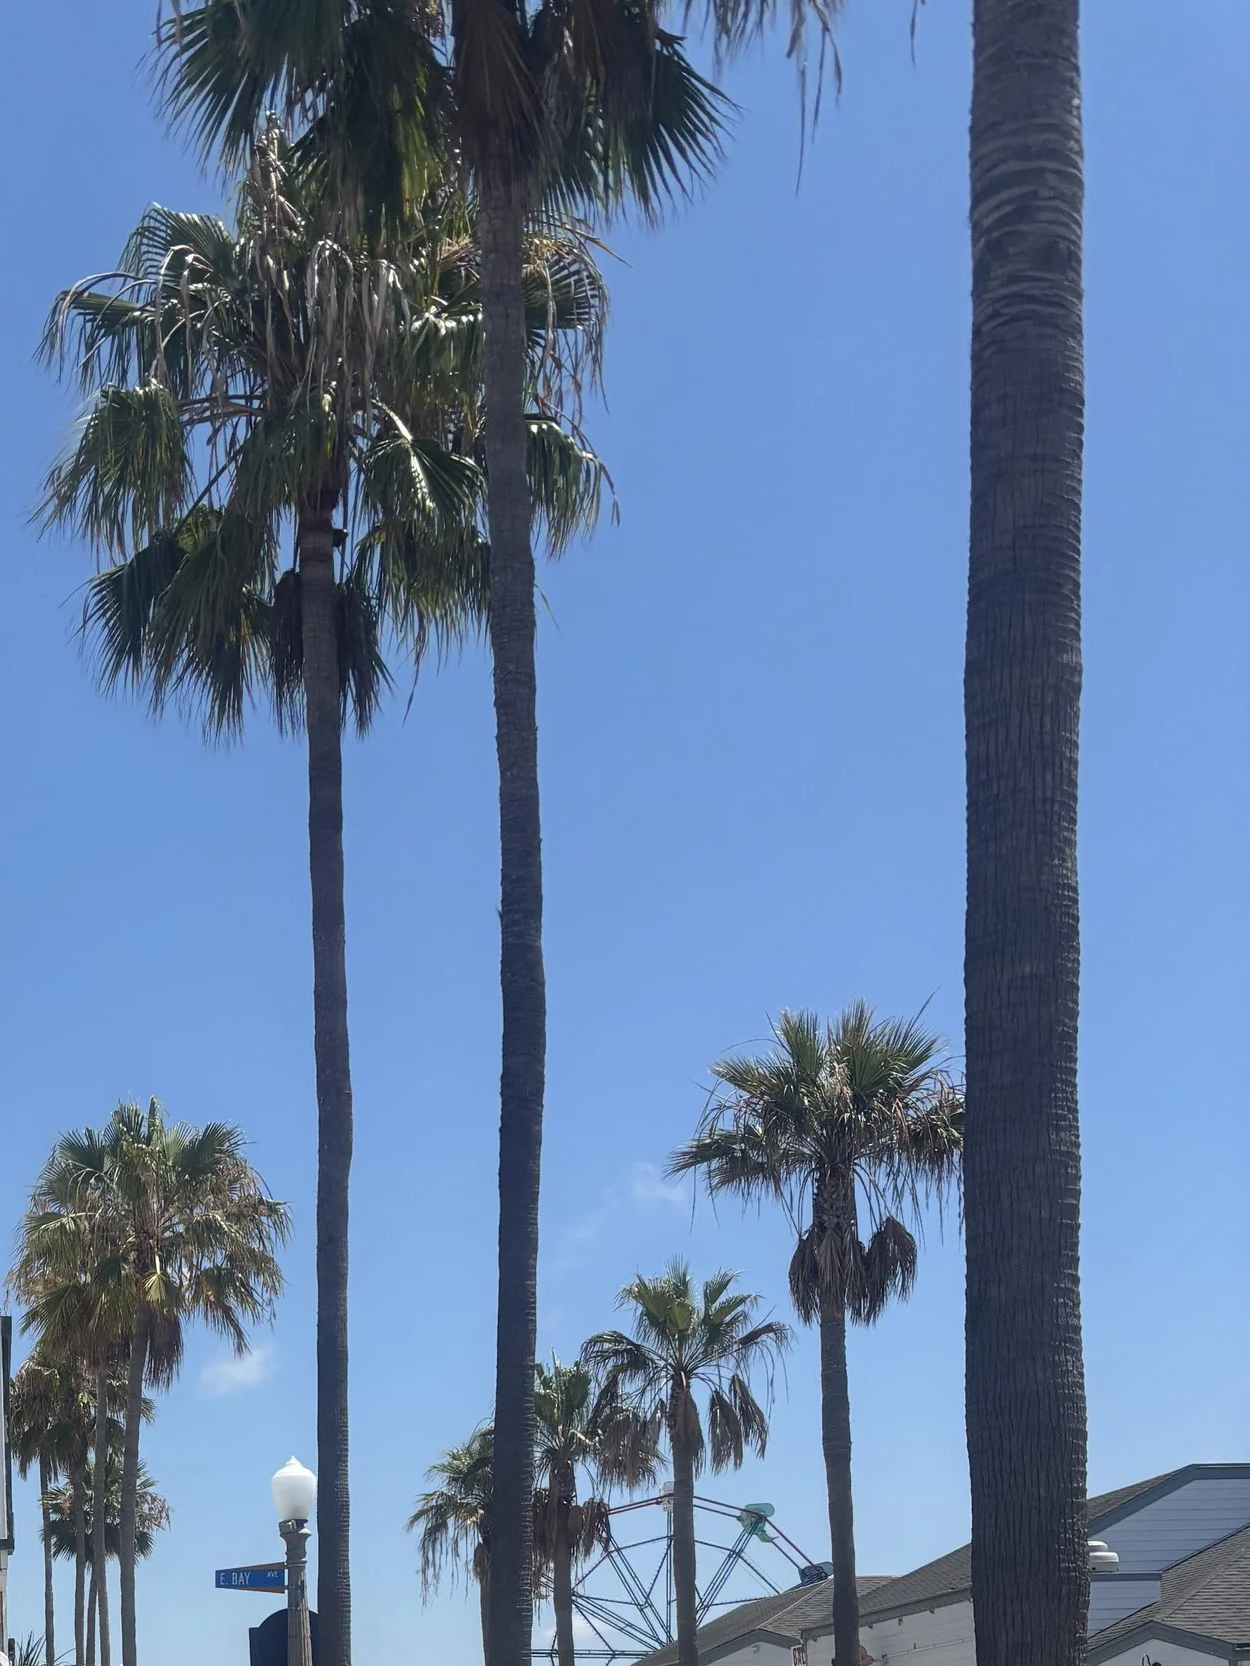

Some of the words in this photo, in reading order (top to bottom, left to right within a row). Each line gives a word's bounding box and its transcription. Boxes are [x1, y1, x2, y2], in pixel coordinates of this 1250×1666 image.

[219, 1573, 229, 1586] E.
[231, 1572, 250, 1585] BAY
[267, 1570, 278, 1578] AVE
[792, 1647, 806, 1666] BAL
